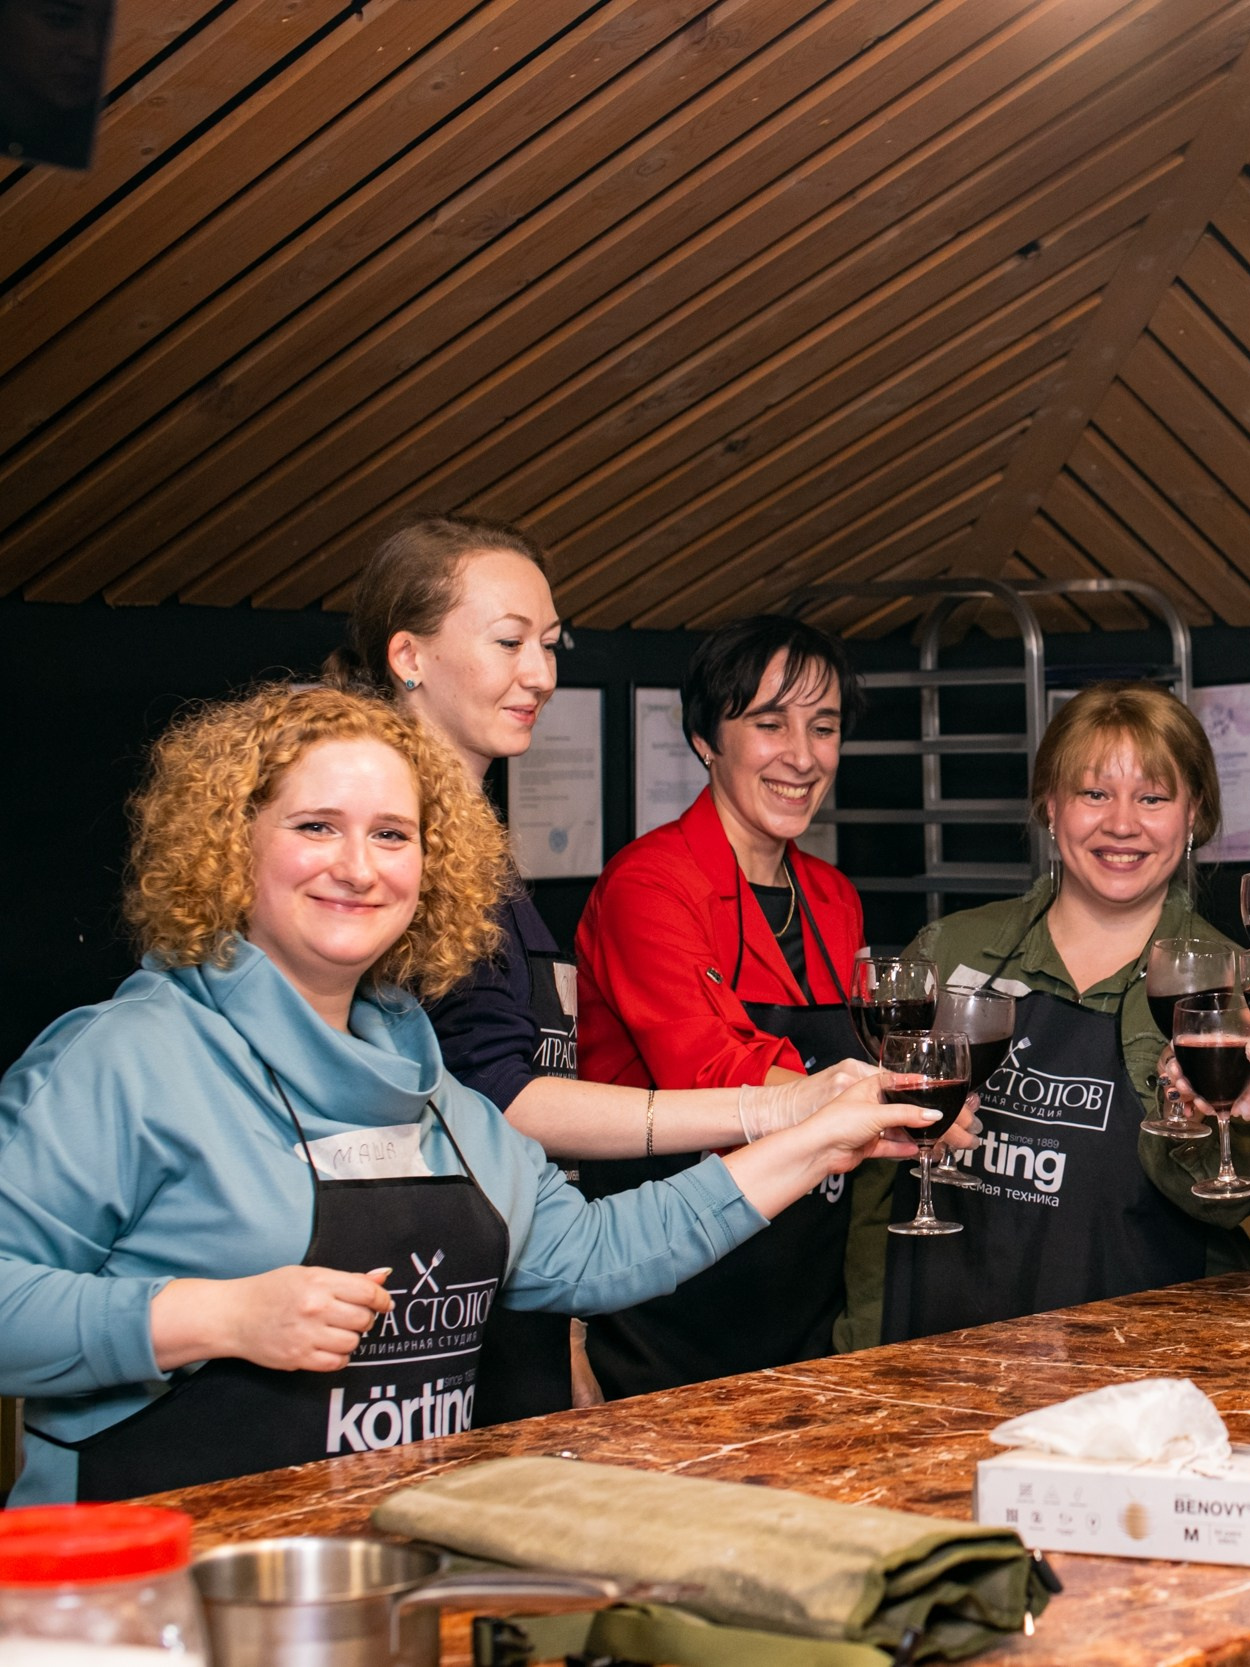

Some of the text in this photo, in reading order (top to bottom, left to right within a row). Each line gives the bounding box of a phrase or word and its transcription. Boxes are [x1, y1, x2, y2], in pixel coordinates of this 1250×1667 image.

[985, 1068, 1103, 1110] СТОЛОВ
[1012, 1101, 1062, 1118] СТУДИЯ
[1009, 1133, 1060, 1149] since 1889
[957, 1130, 1067, 1193] rting
[1005, 1187, 1060, 1207] техника
[405, 1287, 494, 1334] СТОЛО
[438, 1331, 478, 1347] СТУДИЯ
[1174, 1499, 1246, 1517] BENOVY
[1184, 1527, 1199, 1541] M
